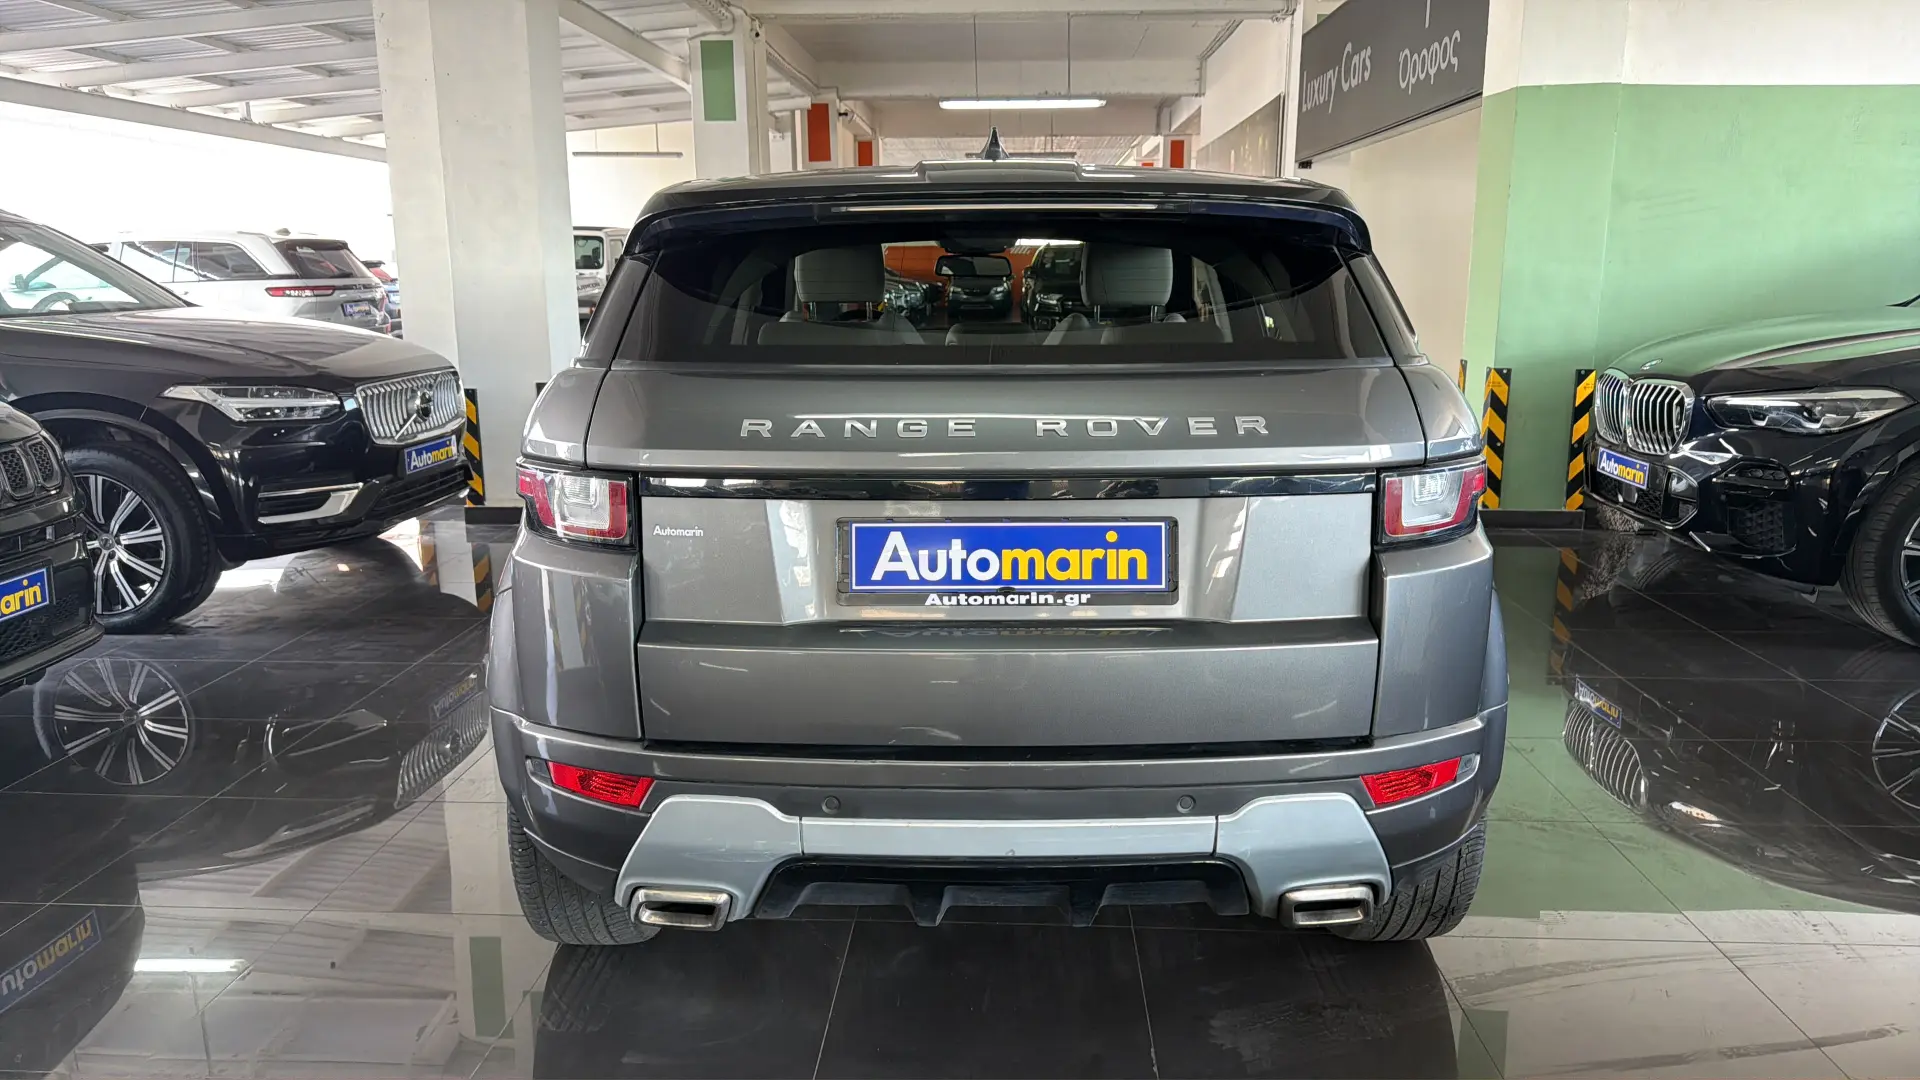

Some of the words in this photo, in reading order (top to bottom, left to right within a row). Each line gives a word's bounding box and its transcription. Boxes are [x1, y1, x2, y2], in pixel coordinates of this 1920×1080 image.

[1302, 66, 1339, 114] Luxury
[1341, 42, 1372, 92] Cars
[740, 418, 976, 438] RANGE
[1035, 415, 1269, 437] ROVER
[1600, 452, 1645, 484] Automarin
[653, 525, 704, 537] Automarin
[870, 530, 1148, 582] Automarin
[0, 579, 42, 614] arin
[924, 592, 1091, 607] Automarin.gr
